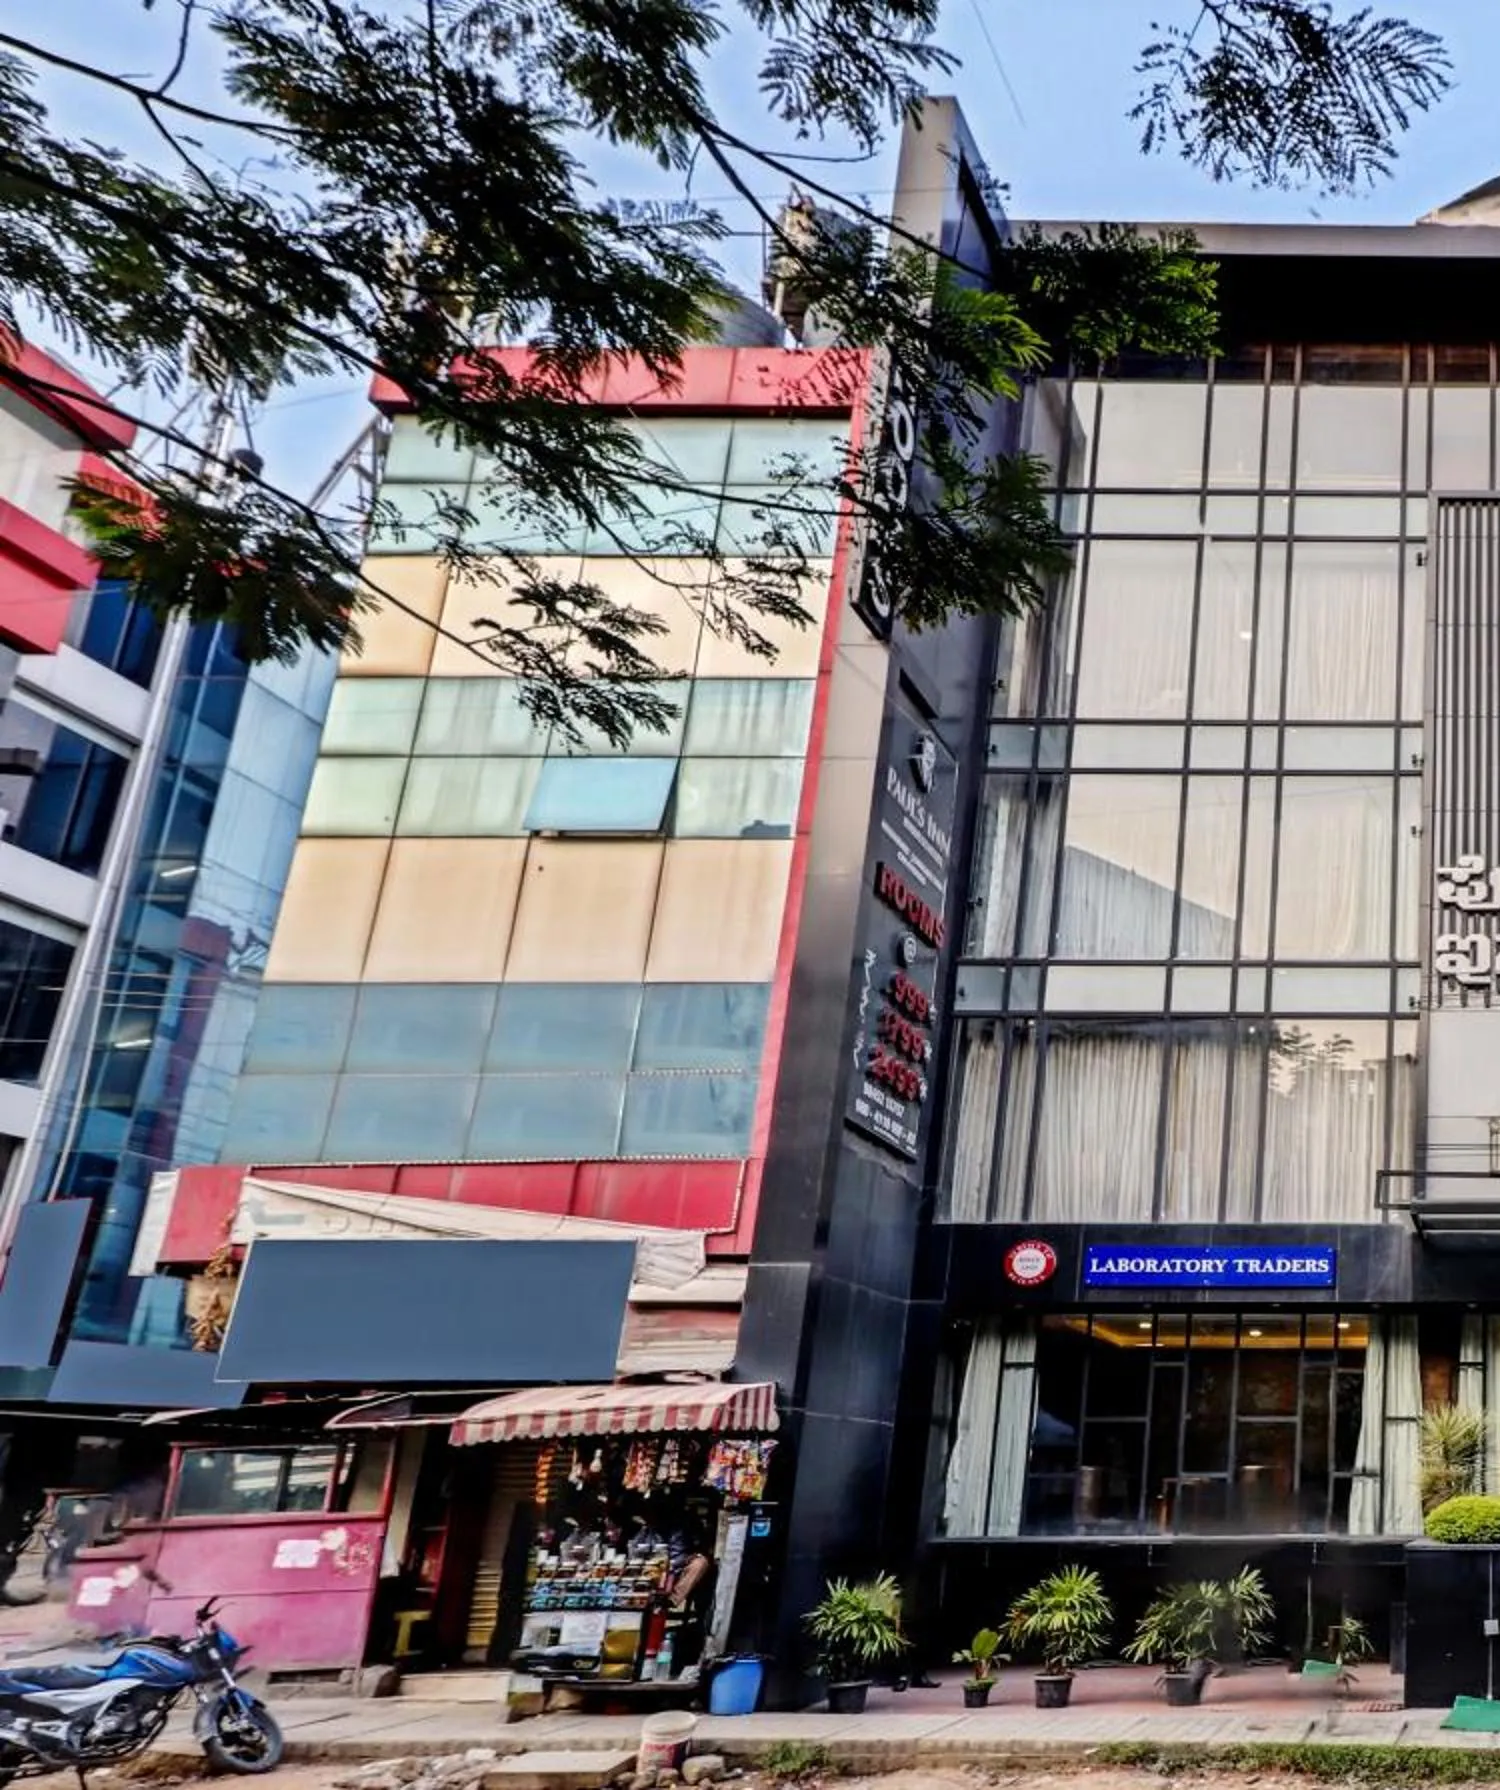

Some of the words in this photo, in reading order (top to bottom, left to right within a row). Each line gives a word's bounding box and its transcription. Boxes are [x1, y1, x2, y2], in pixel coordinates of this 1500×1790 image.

[887, 765, 926, 829] PAUL'S
[878, 863, 947, 949] ROOMS
[1090, 1257, 1227, 1274] LABORATORY
[1232, 1257, 1330, 1274] TRADERS
